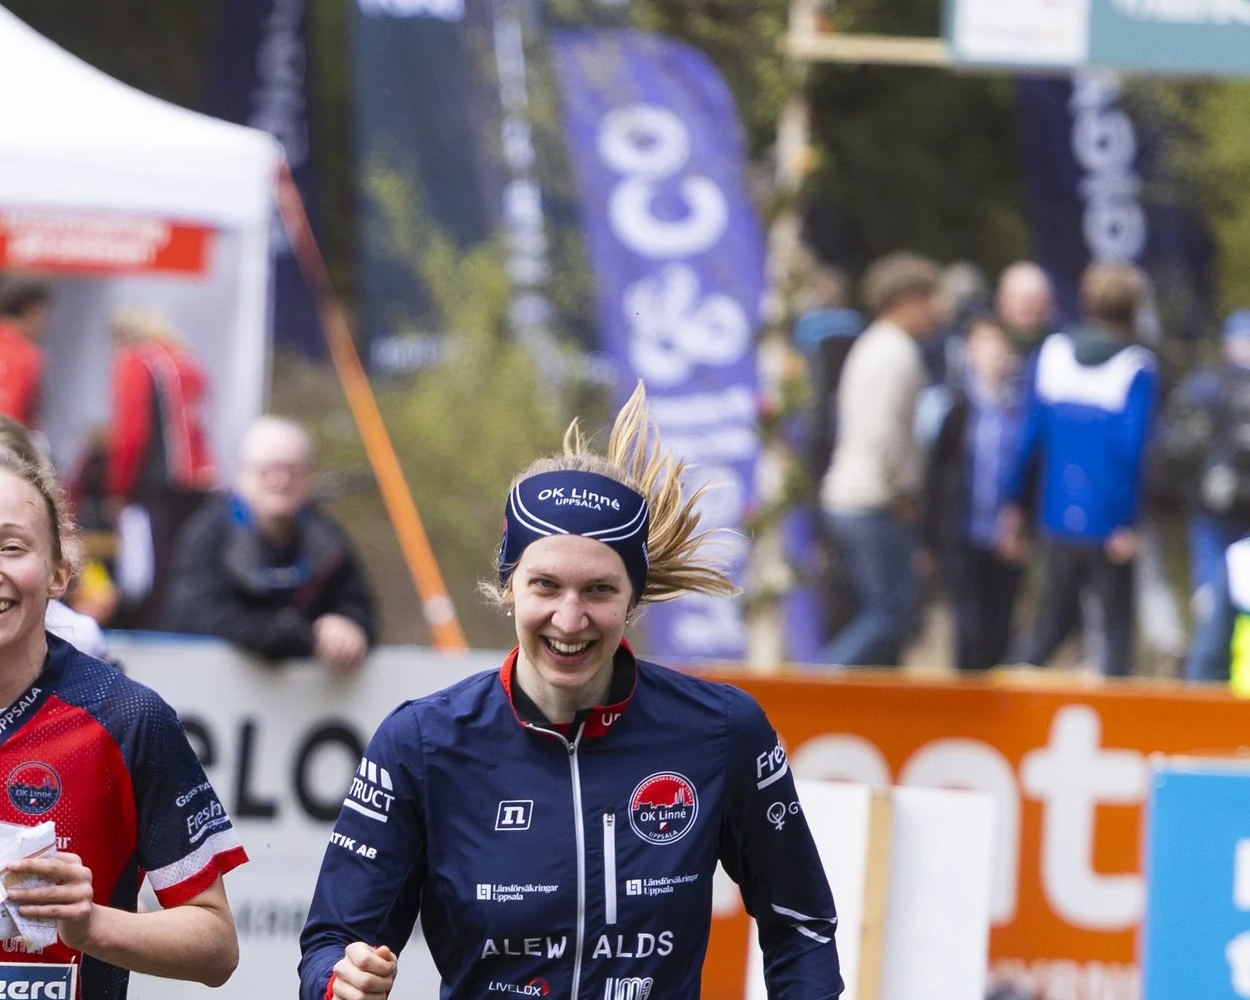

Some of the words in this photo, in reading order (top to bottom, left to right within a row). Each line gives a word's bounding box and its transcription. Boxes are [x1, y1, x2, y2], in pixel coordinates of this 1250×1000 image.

[537, 487, 564, 500] OK
[572, 488, 620, 511] Linné
[555, 498, 602, 511] UPPSALA
[187, 800, 223, 835] Fresh
[640, 811, 656, 822] OK
[659, 808, 686, 821] Linné
[649, 829, 678, 840] UPPSALA
[356, 844, 378, 859] AB
[644, 873, 699, 887] Länsförsäkringar
[493, 883, 558, 893] Länsförsäkringar
[644, 885, 674, 896] Uppsala
[493, 892, 524, 902] Uppsala
[481, 936, 567, 959] ALEW
[592, 931, 674, 959] ALDS
[488, 981, 542, 997] LIVELOX
